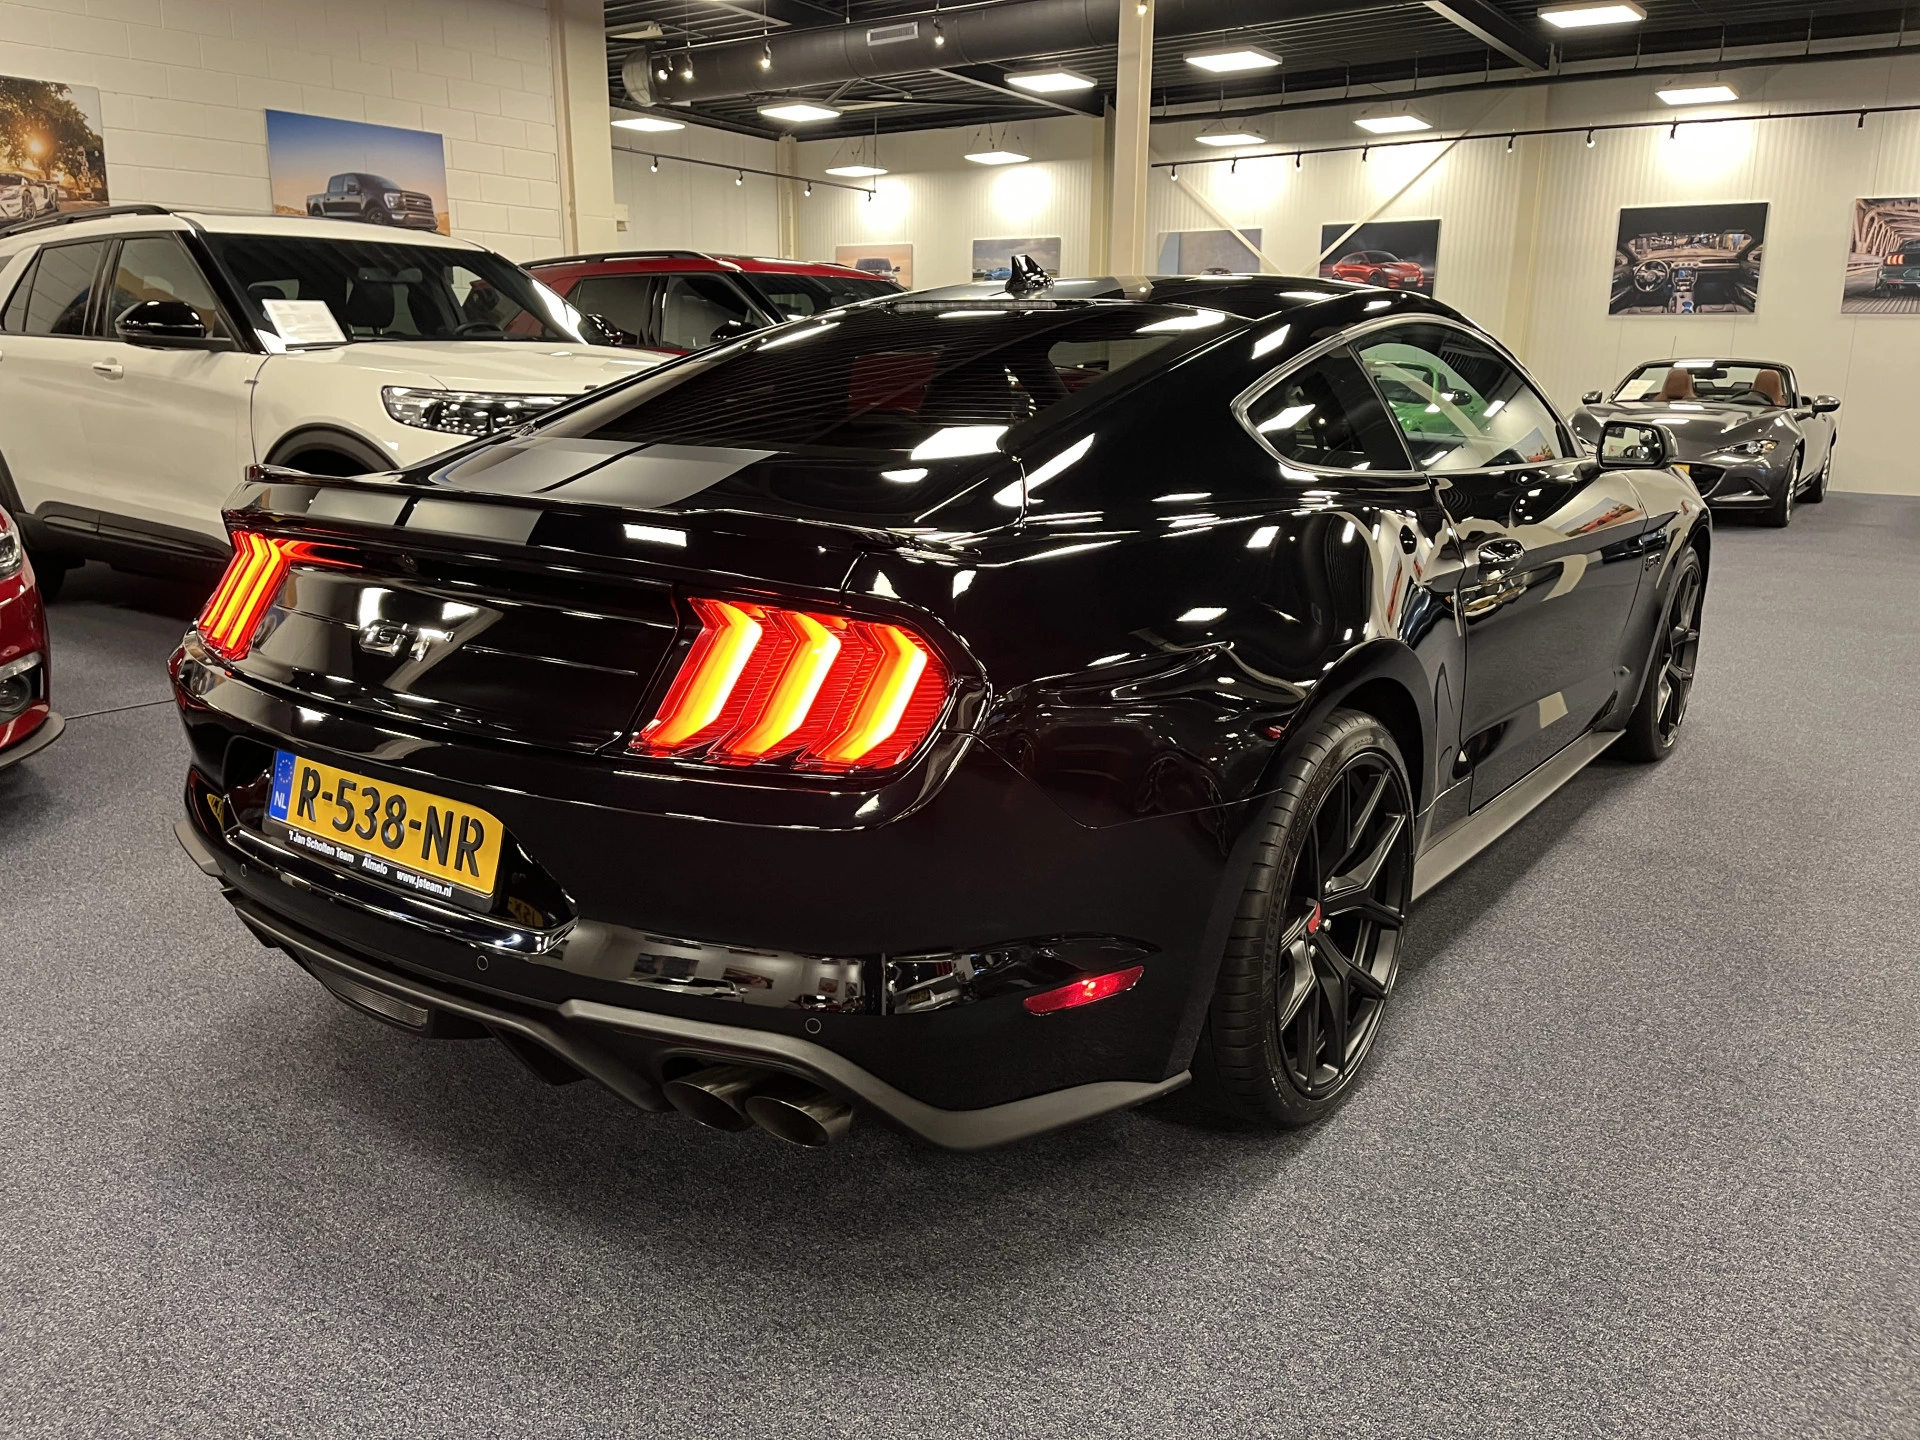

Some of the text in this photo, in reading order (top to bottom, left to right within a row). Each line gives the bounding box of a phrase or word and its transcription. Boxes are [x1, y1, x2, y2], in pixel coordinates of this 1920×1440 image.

[359, 619, 455, 662] GT
[273, 790, 287, 810] NL
[296, 766, 485, 878] R-538-NR
[293, 832, 306, 846] Jan
[336, 846, 355, 863] Team
[361, 857, 389, 875] Almelo
[396, 869, 453, 898] www.jsteam.nl
